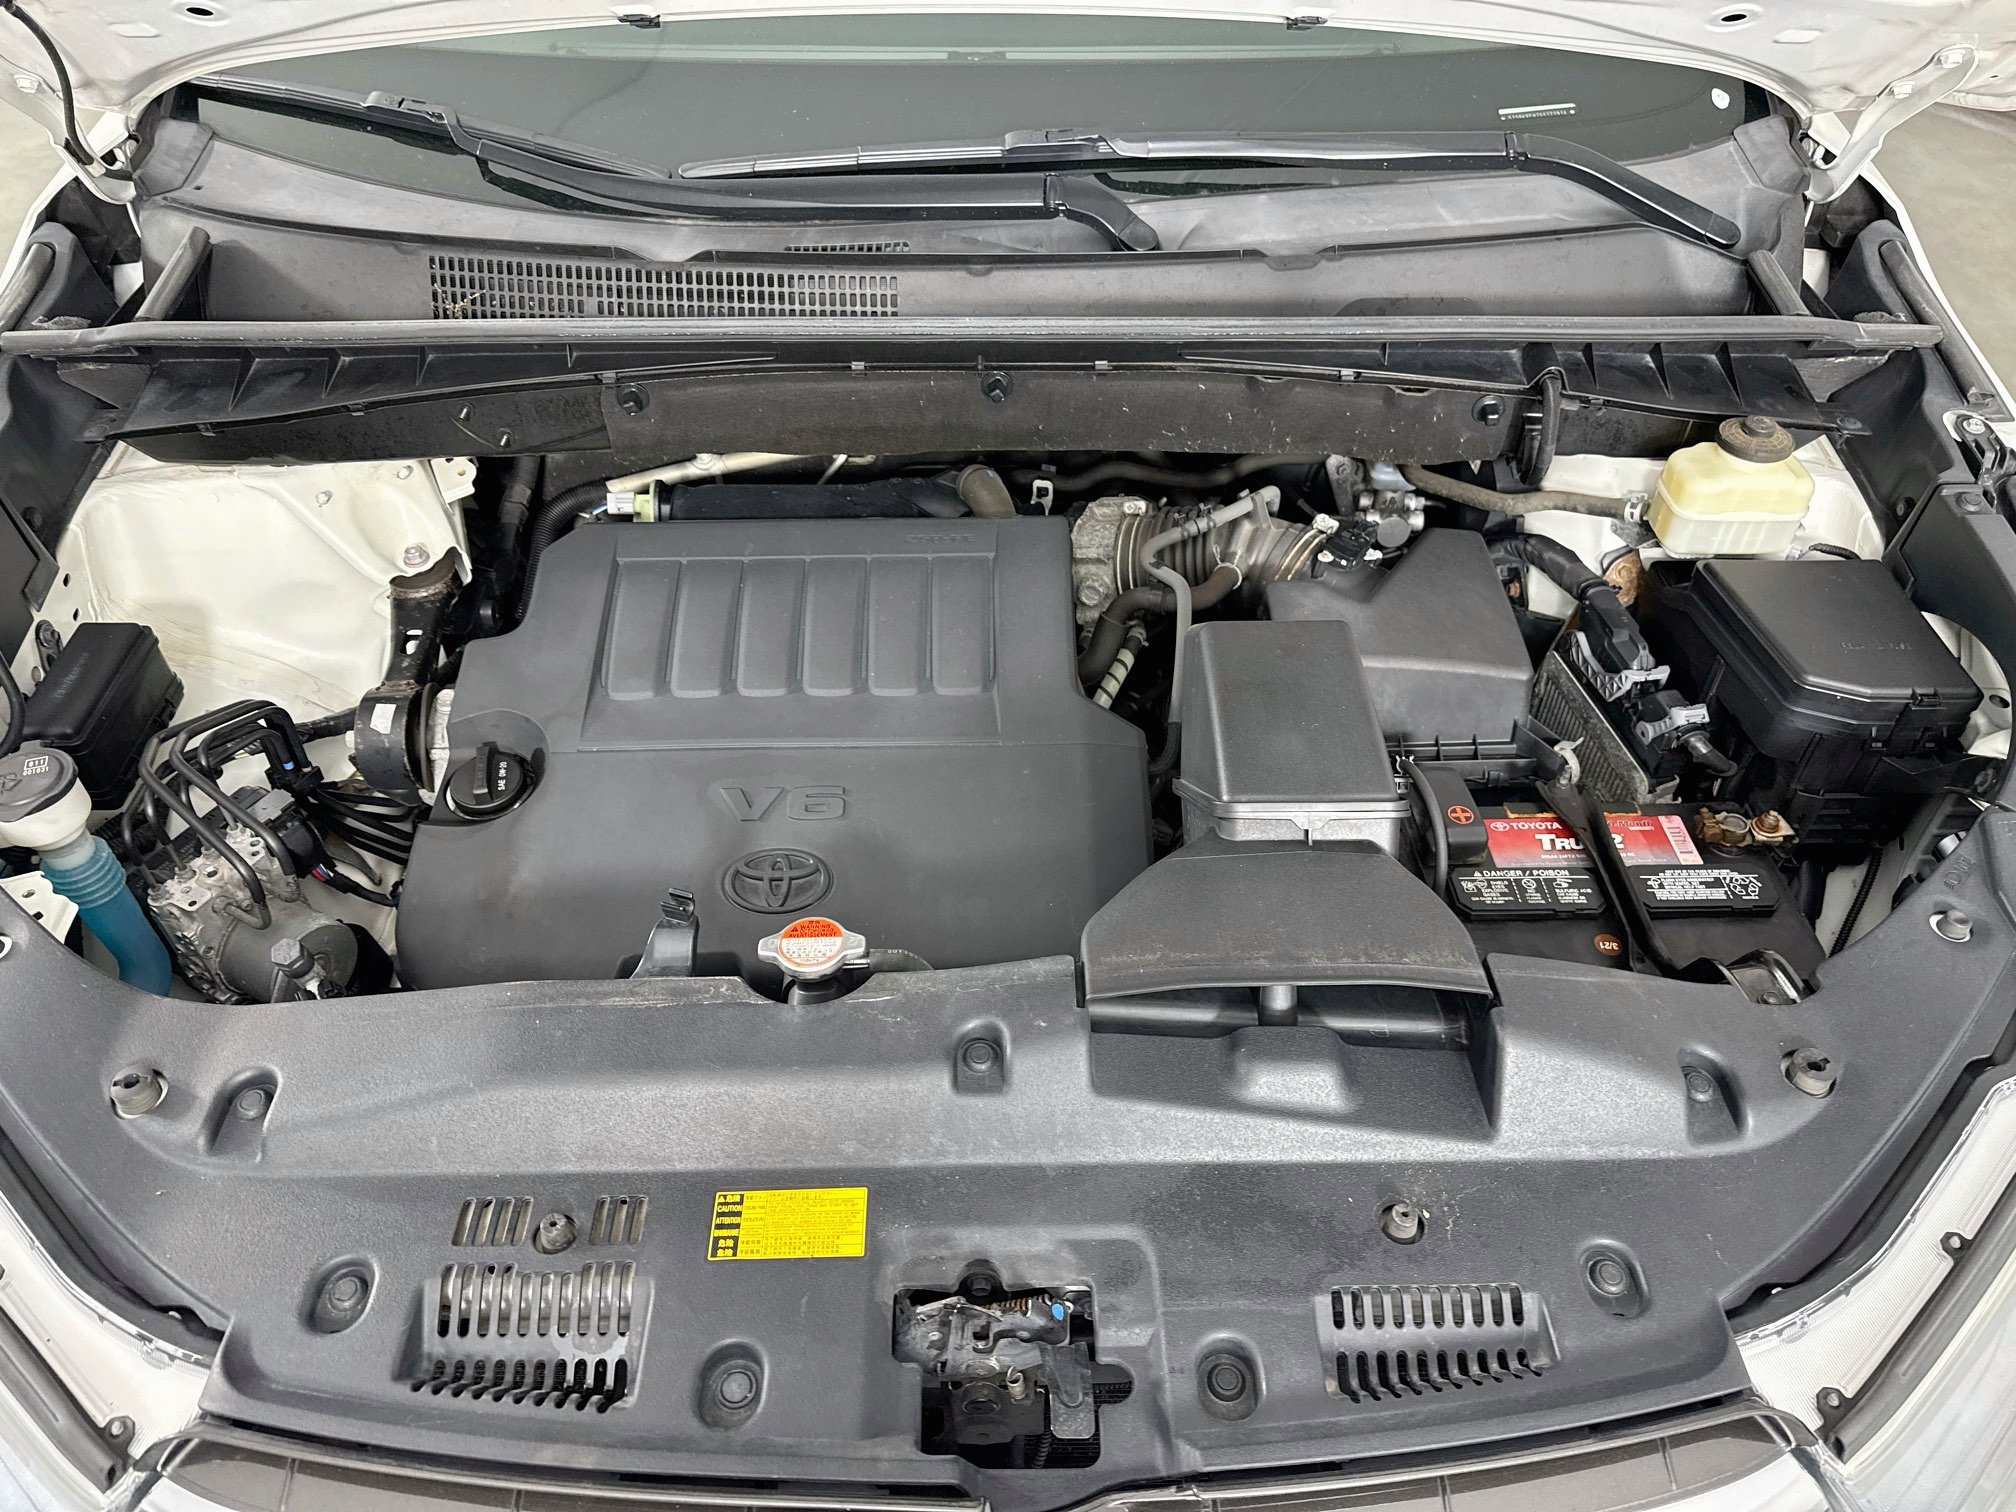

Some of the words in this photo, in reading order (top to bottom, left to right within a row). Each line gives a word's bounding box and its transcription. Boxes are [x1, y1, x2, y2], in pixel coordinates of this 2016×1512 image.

[497, 779, 506, 790] SAE
[720, 785, 846, 821] V6
[1510, 822, 1562, 830] TOYOTA
[1534, 833, 1585, 851] TRU
[1599, 940, 1619, 950] 3/21
[717, 1204, 742, 1212] CAUTION
